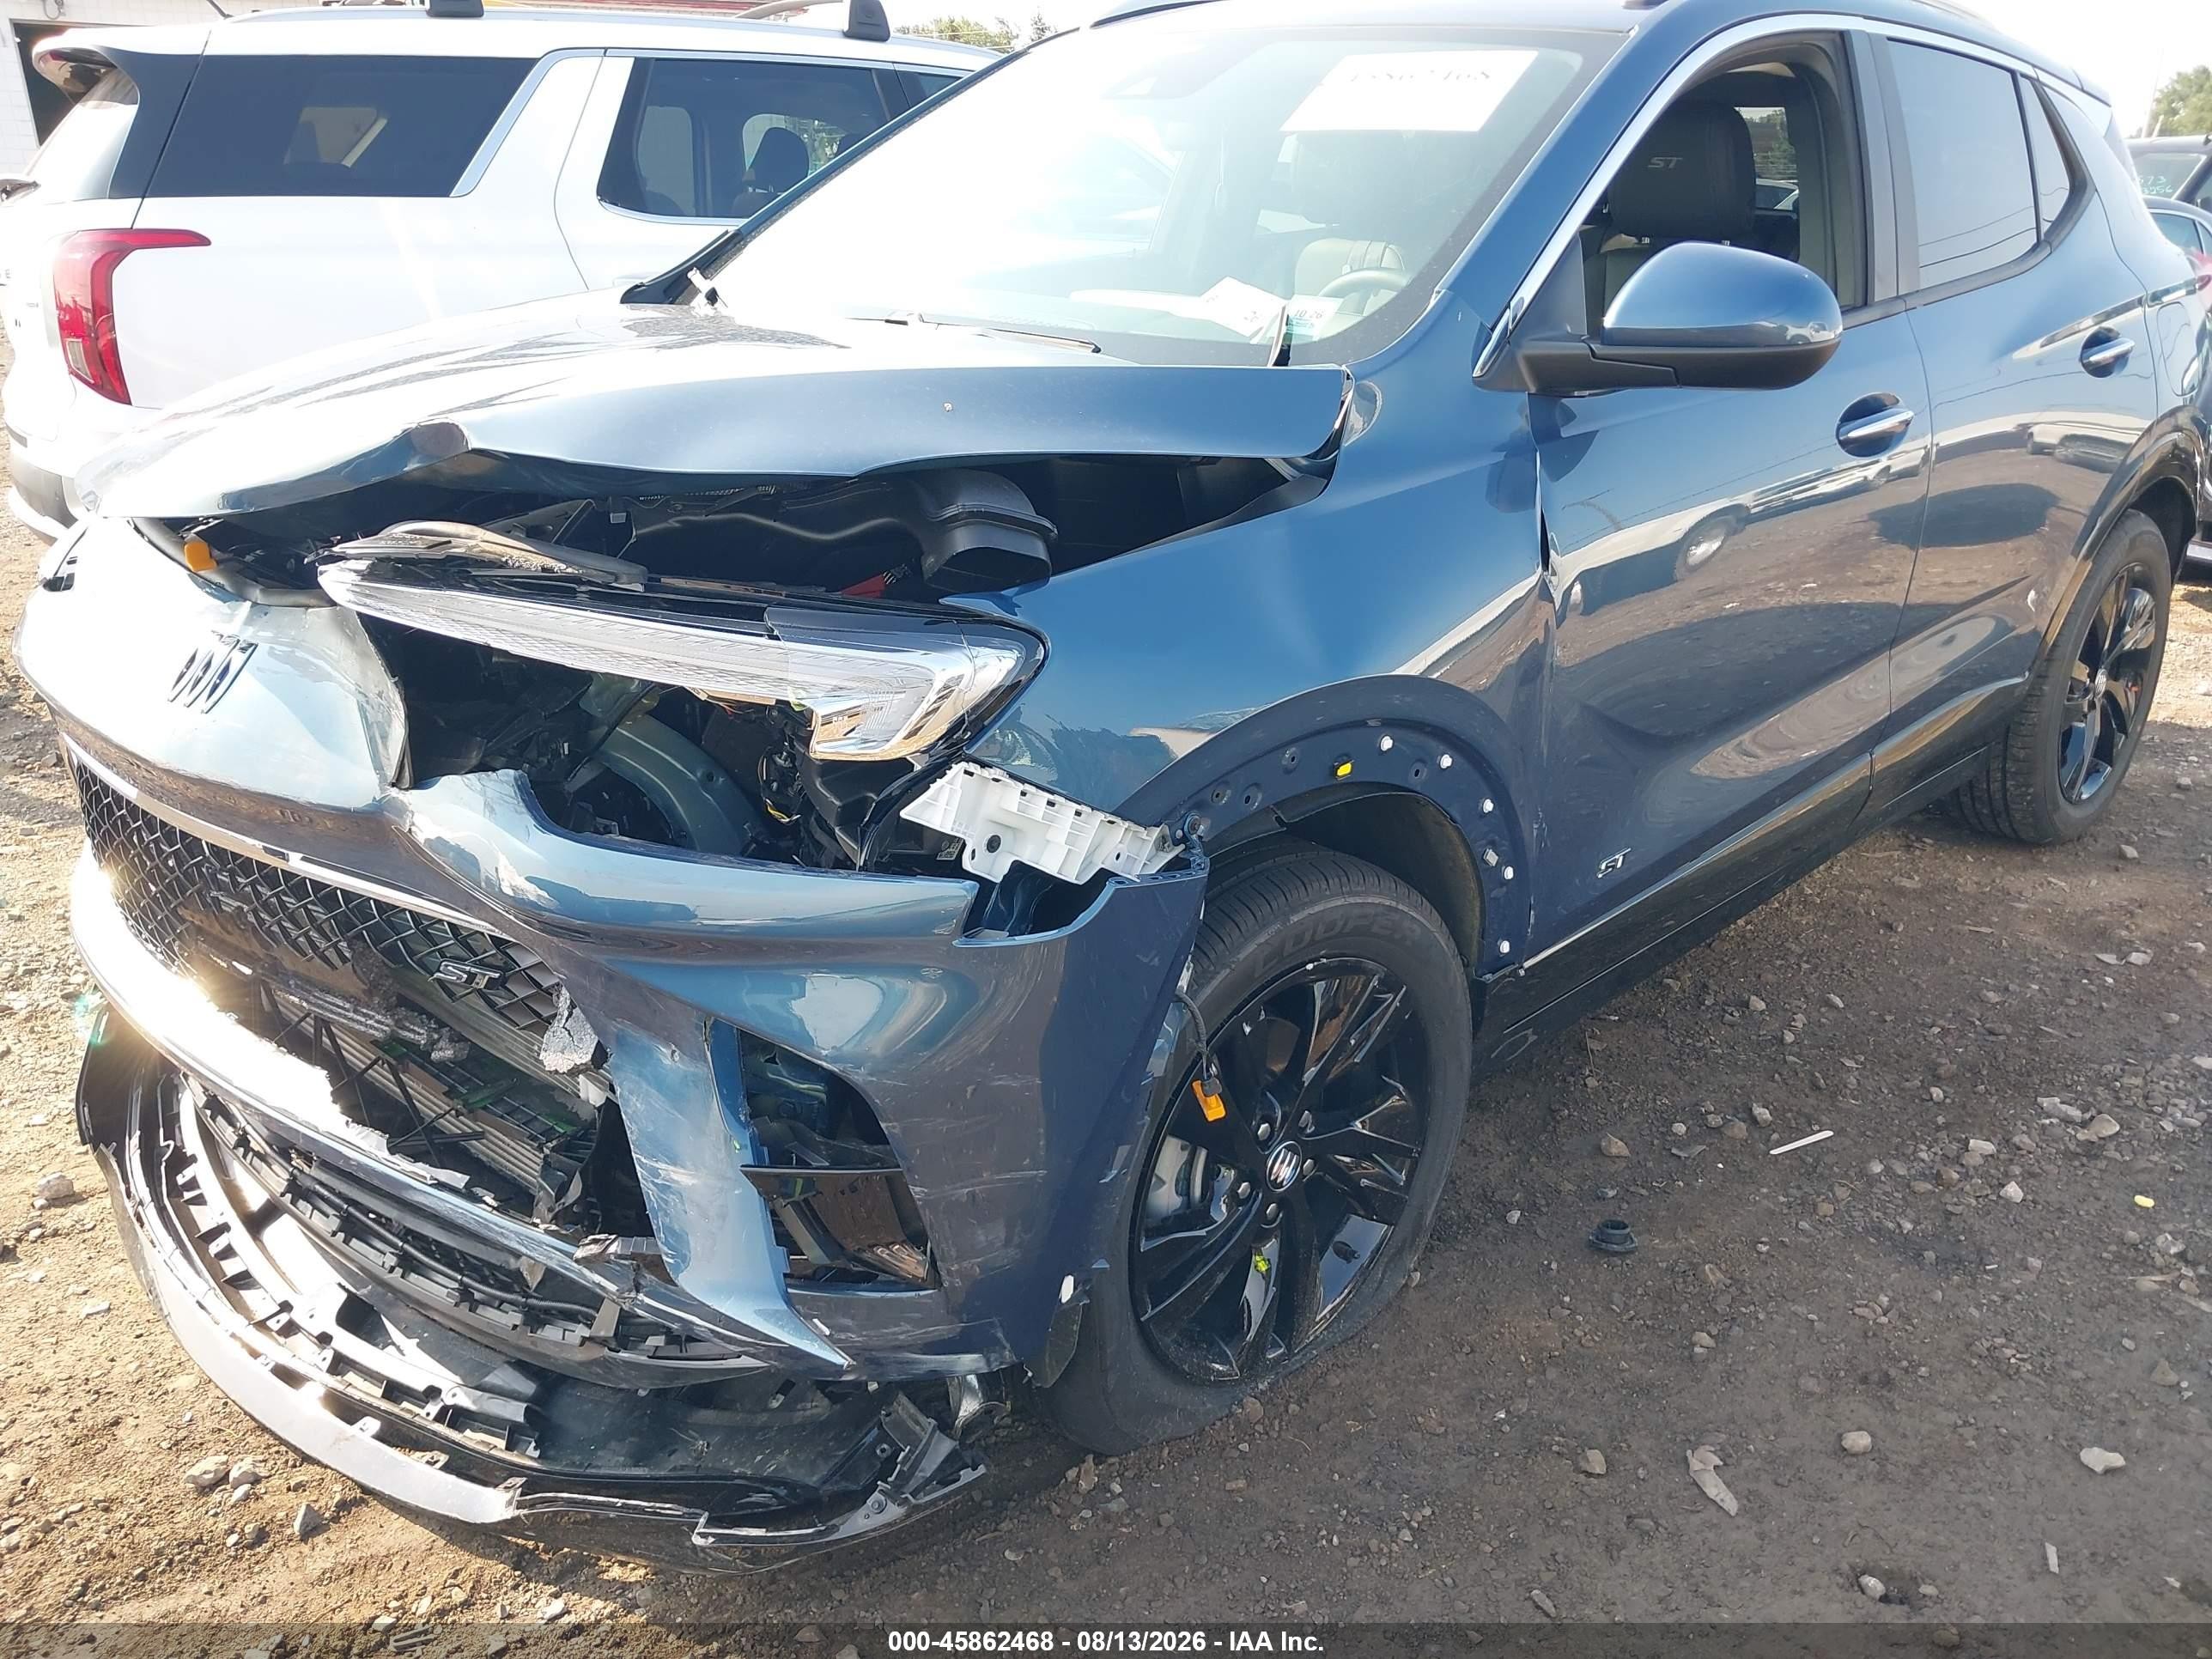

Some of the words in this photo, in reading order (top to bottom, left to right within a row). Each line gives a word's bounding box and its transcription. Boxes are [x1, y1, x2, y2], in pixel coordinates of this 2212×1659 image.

[1648, 157, 1683, 168] ST
[1596, 848, 1632, 878] ST
[428, 961, 501, 989] ST
